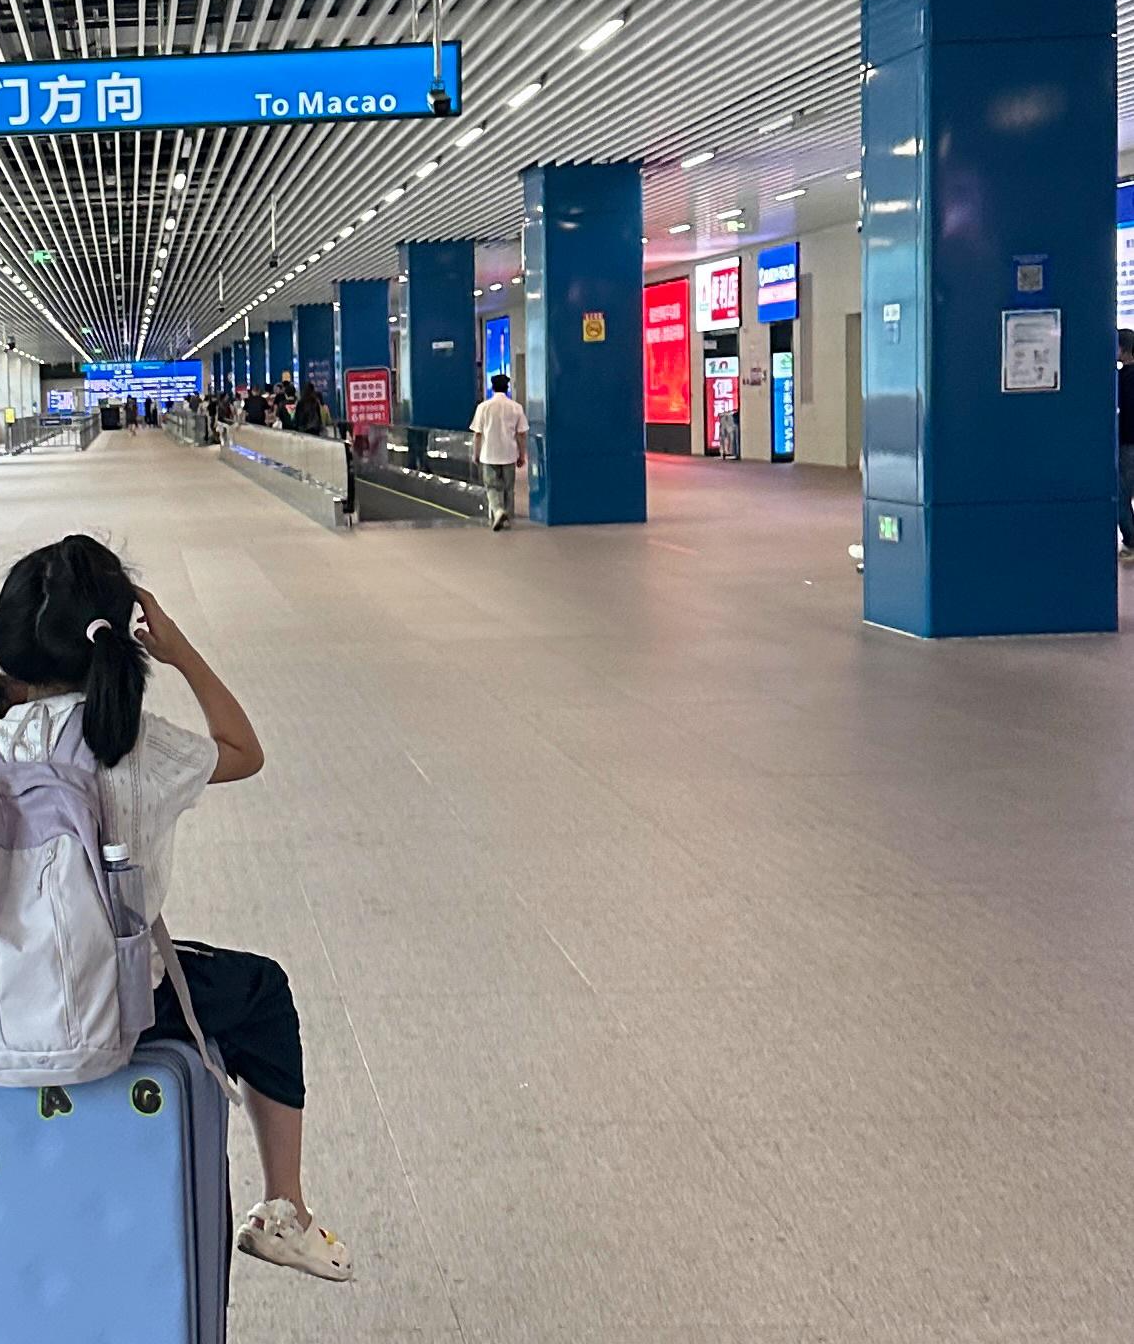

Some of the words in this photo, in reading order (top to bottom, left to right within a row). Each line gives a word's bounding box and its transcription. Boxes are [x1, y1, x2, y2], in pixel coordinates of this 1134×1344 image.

[254, 92, 290, 117] To
[298, 90, 397, 115] Macao
[130, 1077, 163, 1116] G
